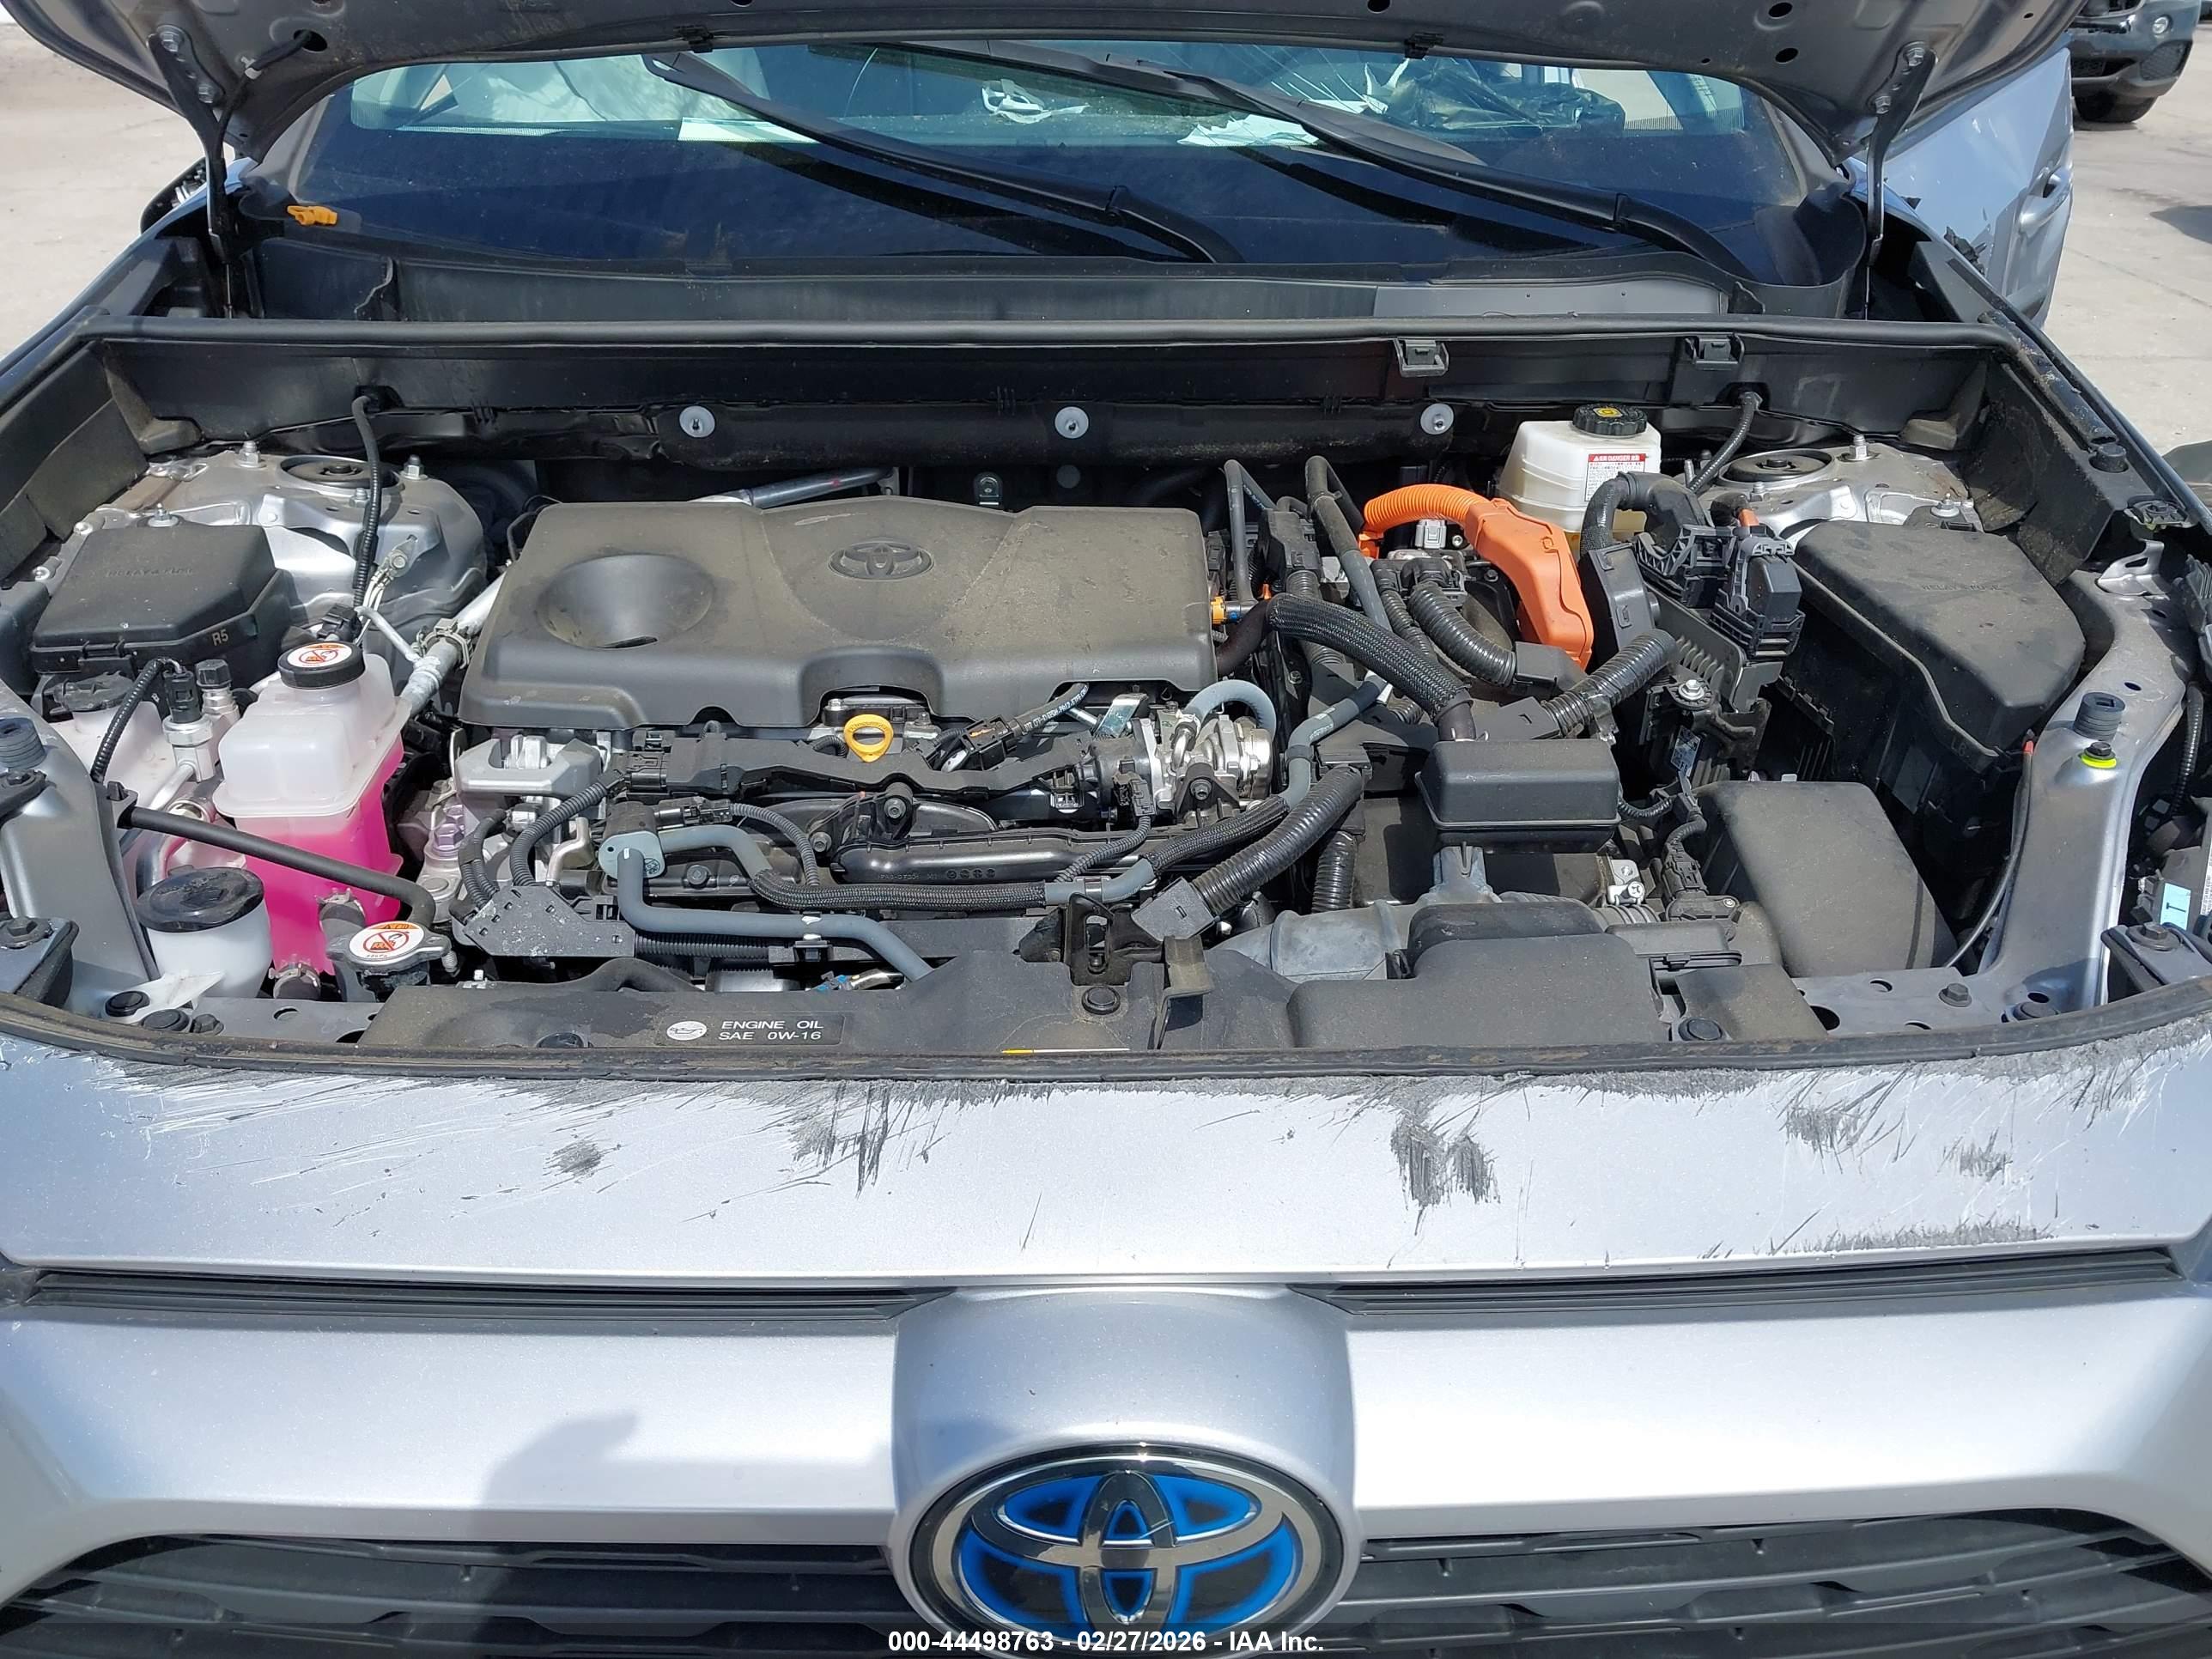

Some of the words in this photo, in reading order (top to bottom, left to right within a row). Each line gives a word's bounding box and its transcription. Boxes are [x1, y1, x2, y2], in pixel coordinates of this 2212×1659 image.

[211, 629, 229, 646] R5
[720, 1020, 786, 1030] ENGINE
[796, 1020, 824, 1030] OIL
[718, 1030, 755, 1040] SAE
[767, 1030, 822, 1041] 0W-16
